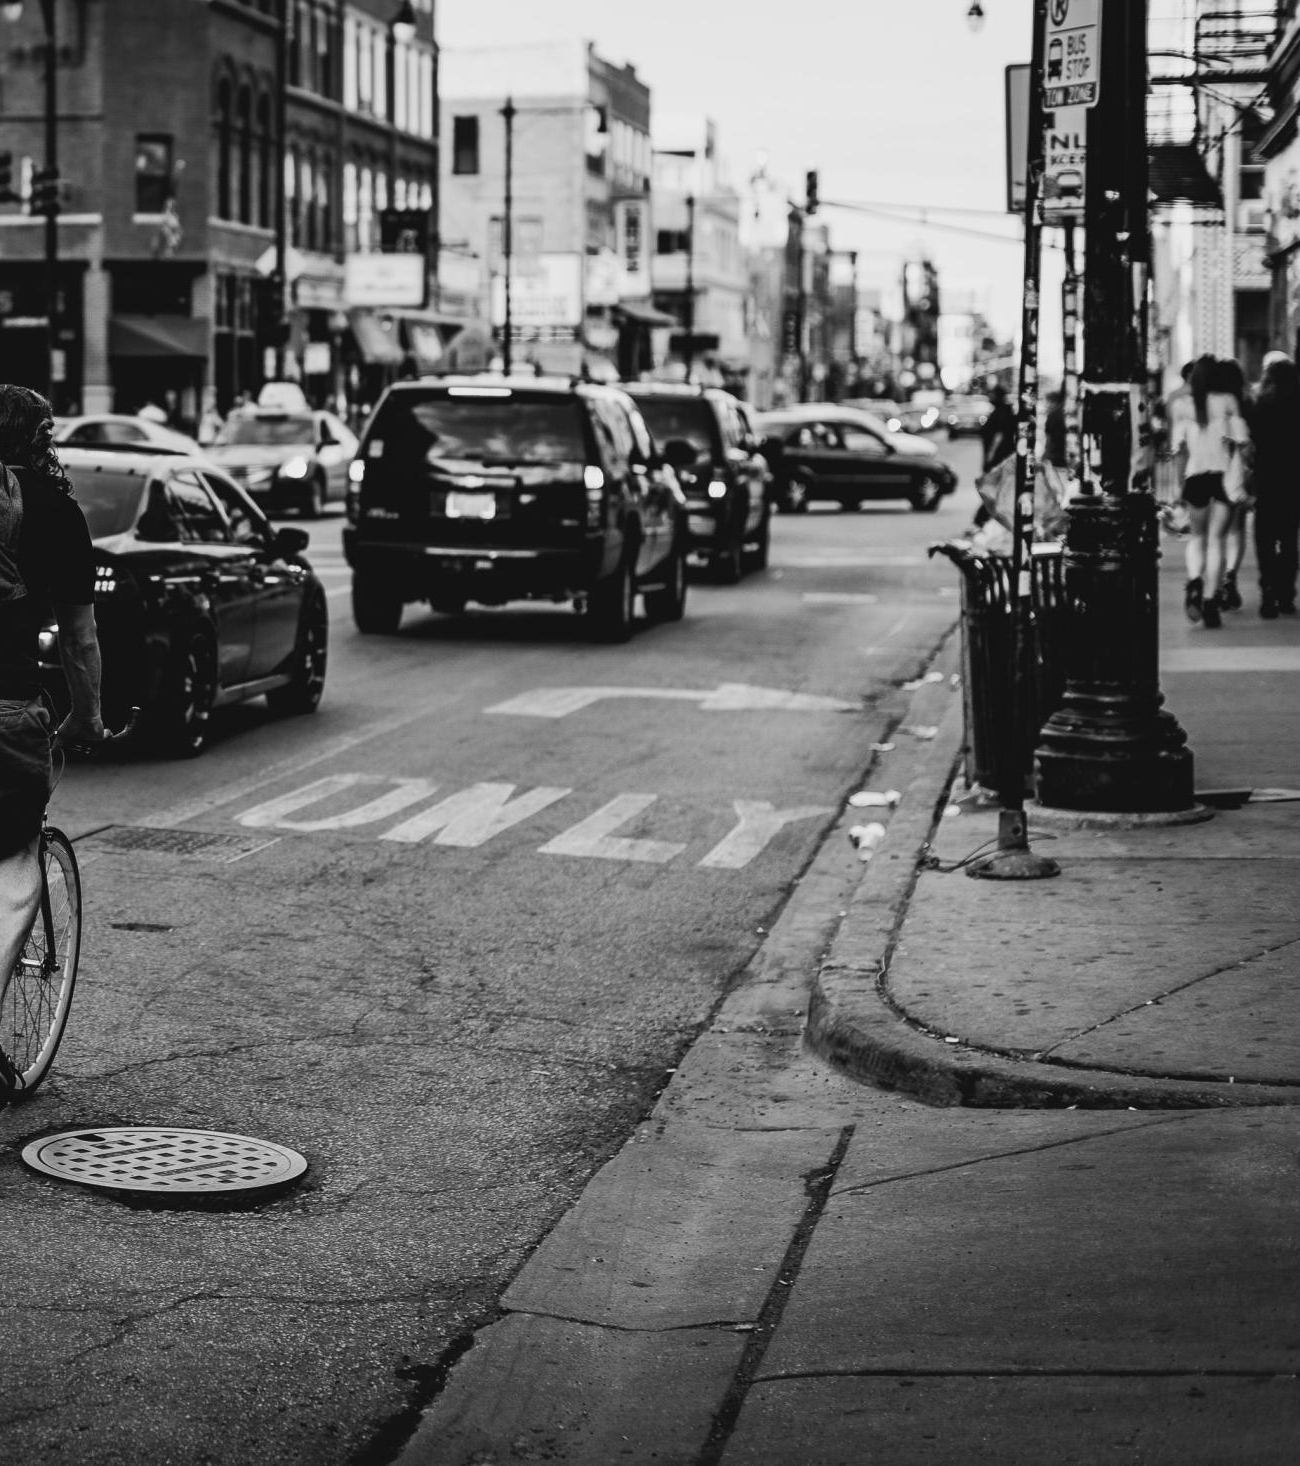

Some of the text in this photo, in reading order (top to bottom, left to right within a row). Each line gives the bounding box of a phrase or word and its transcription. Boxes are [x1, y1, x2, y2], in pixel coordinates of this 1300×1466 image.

[1067, 33, 1087, 56] BUS
[1066, 57, 1090, 80] STOP
[1045, 83, 1093, 107] TOW ZONE
[1050, 134, 1086, 149] NL
[233, 772, 836, 870] ONLY
